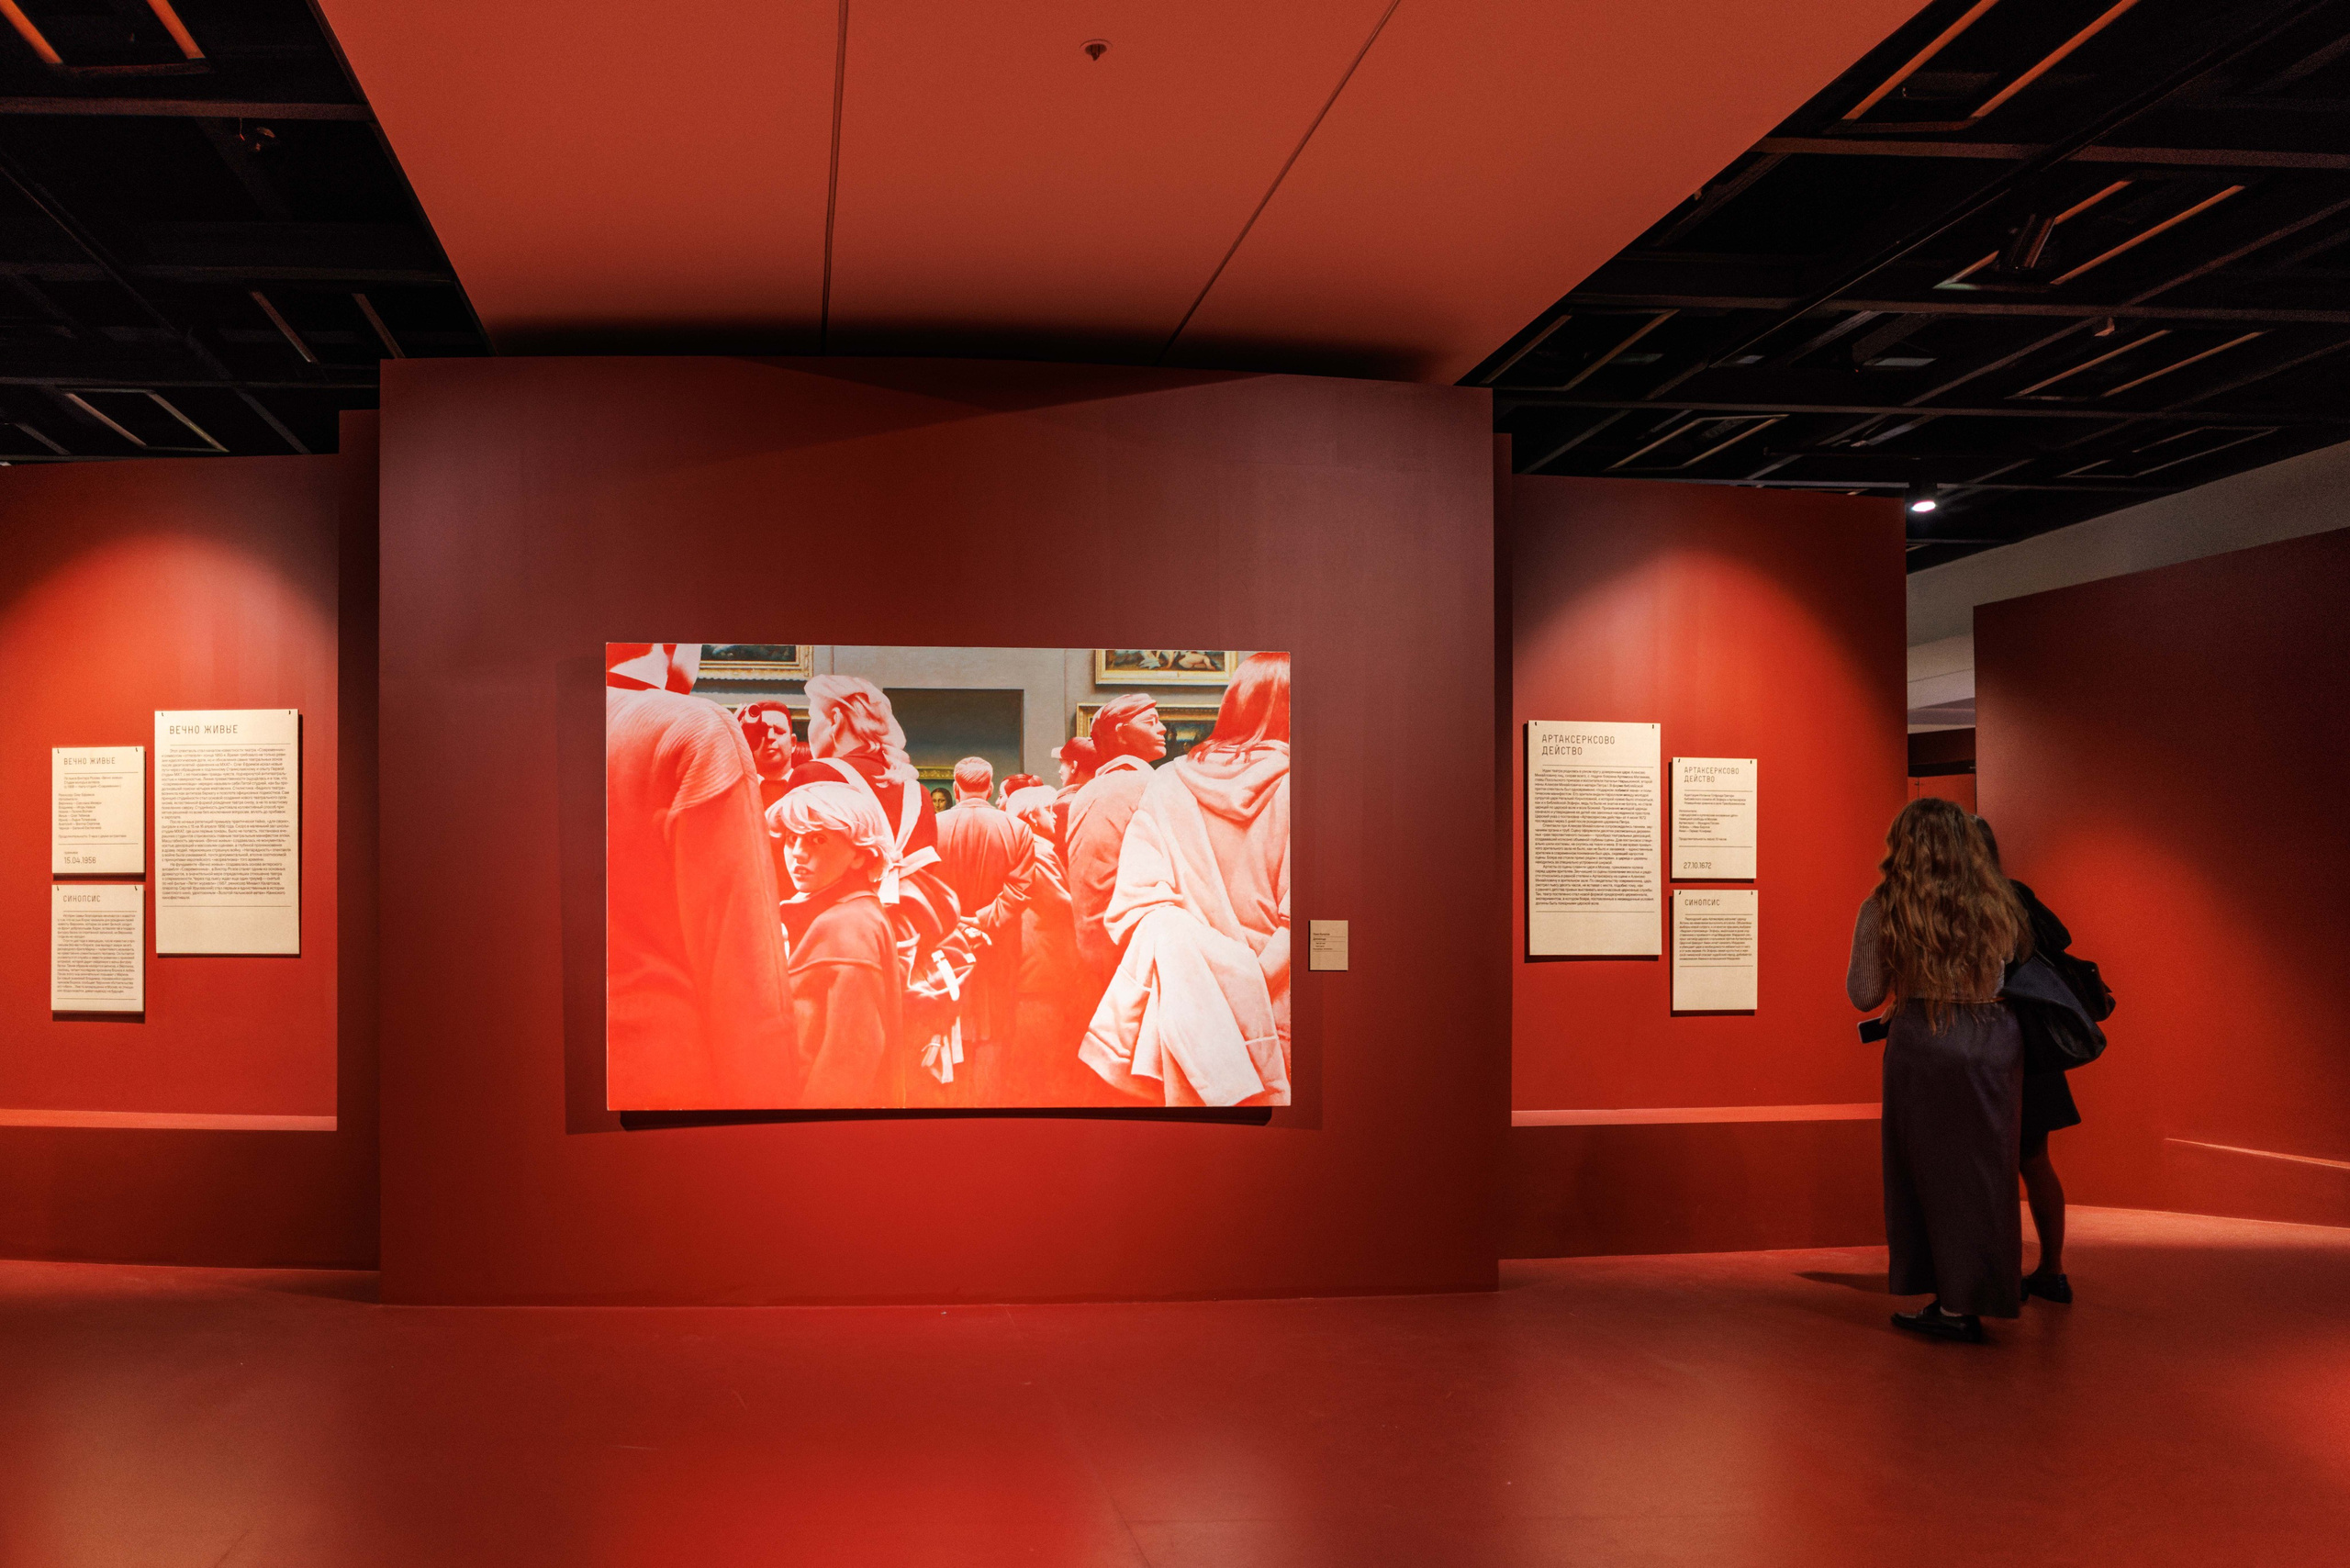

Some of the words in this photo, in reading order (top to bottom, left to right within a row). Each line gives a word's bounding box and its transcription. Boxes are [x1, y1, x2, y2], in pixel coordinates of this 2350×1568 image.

[169, 724, 200, 734] ВЕЧНО
[204, 724, 239, 734] ЖИВЫЕ
[1541, 734, 1616, 745] АРТАКСЕРКСОВО
[1541, 745, 1583, 756] ДЕЙСТВО
[90, 756, 116, 765] ЖИВЫЕ
[1684, 767, 1740, 775] АРТАКСЕРКСОВО
[1684, 774, 1716, 783] ДЕЙСТВО
[1683, 861, 1712, 869] 27.10.1672
[62, 894, 101, 902] СИНОПСИС
